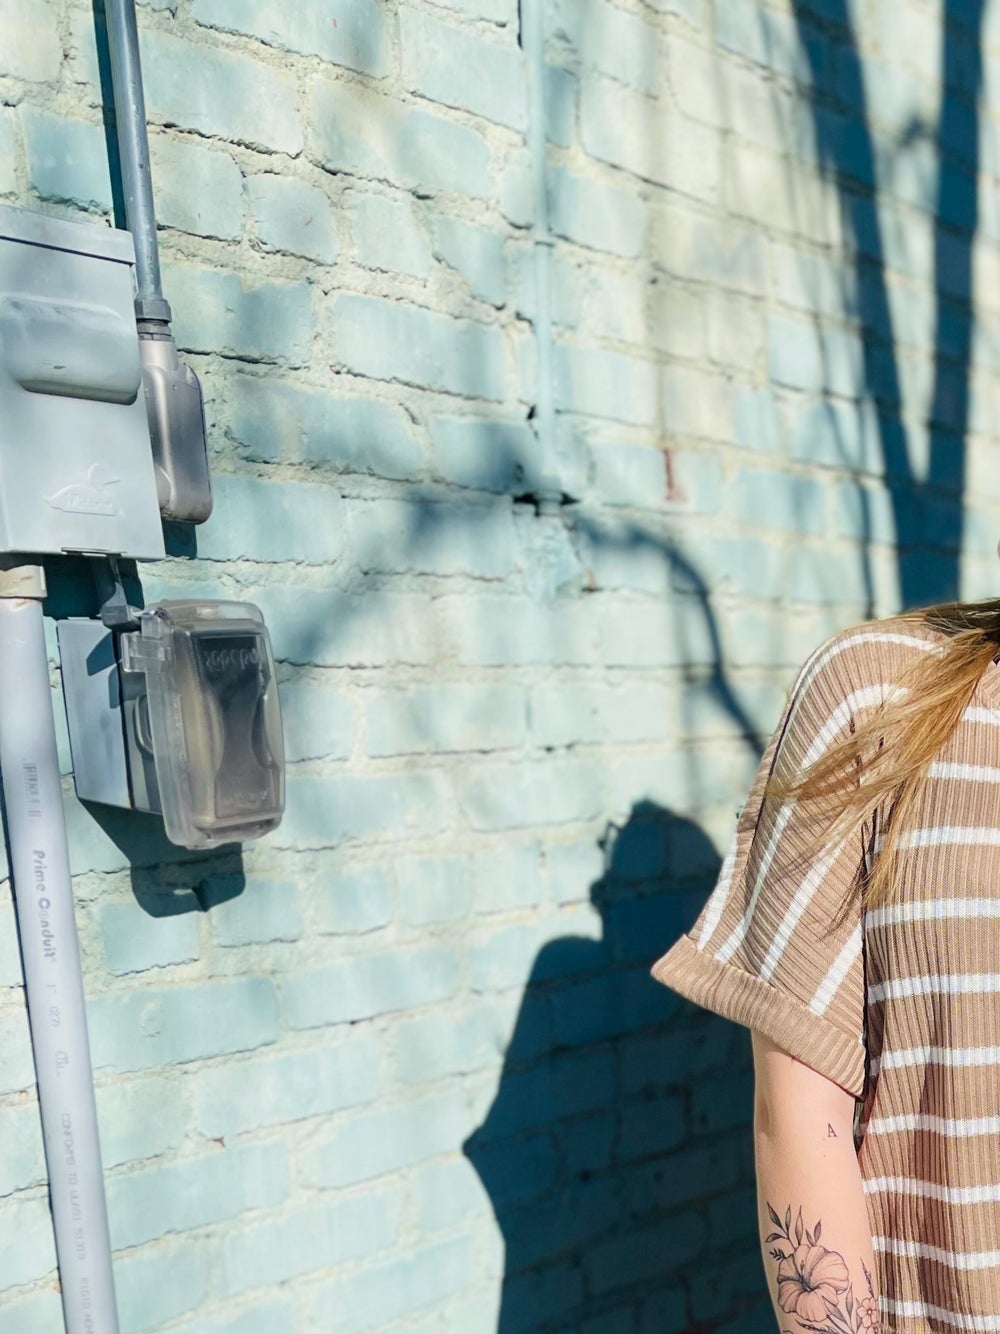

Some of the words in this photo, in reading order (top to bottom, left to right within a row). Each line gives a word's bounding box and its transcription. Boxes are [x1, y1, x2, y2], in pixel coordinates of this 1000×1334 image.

[32, 849, 47, 892] Prime
[38, 897, 56, 958] Conduit
[828, 1123, 838, 1137] A
[79, 1277, 92, 1310] RIGID
